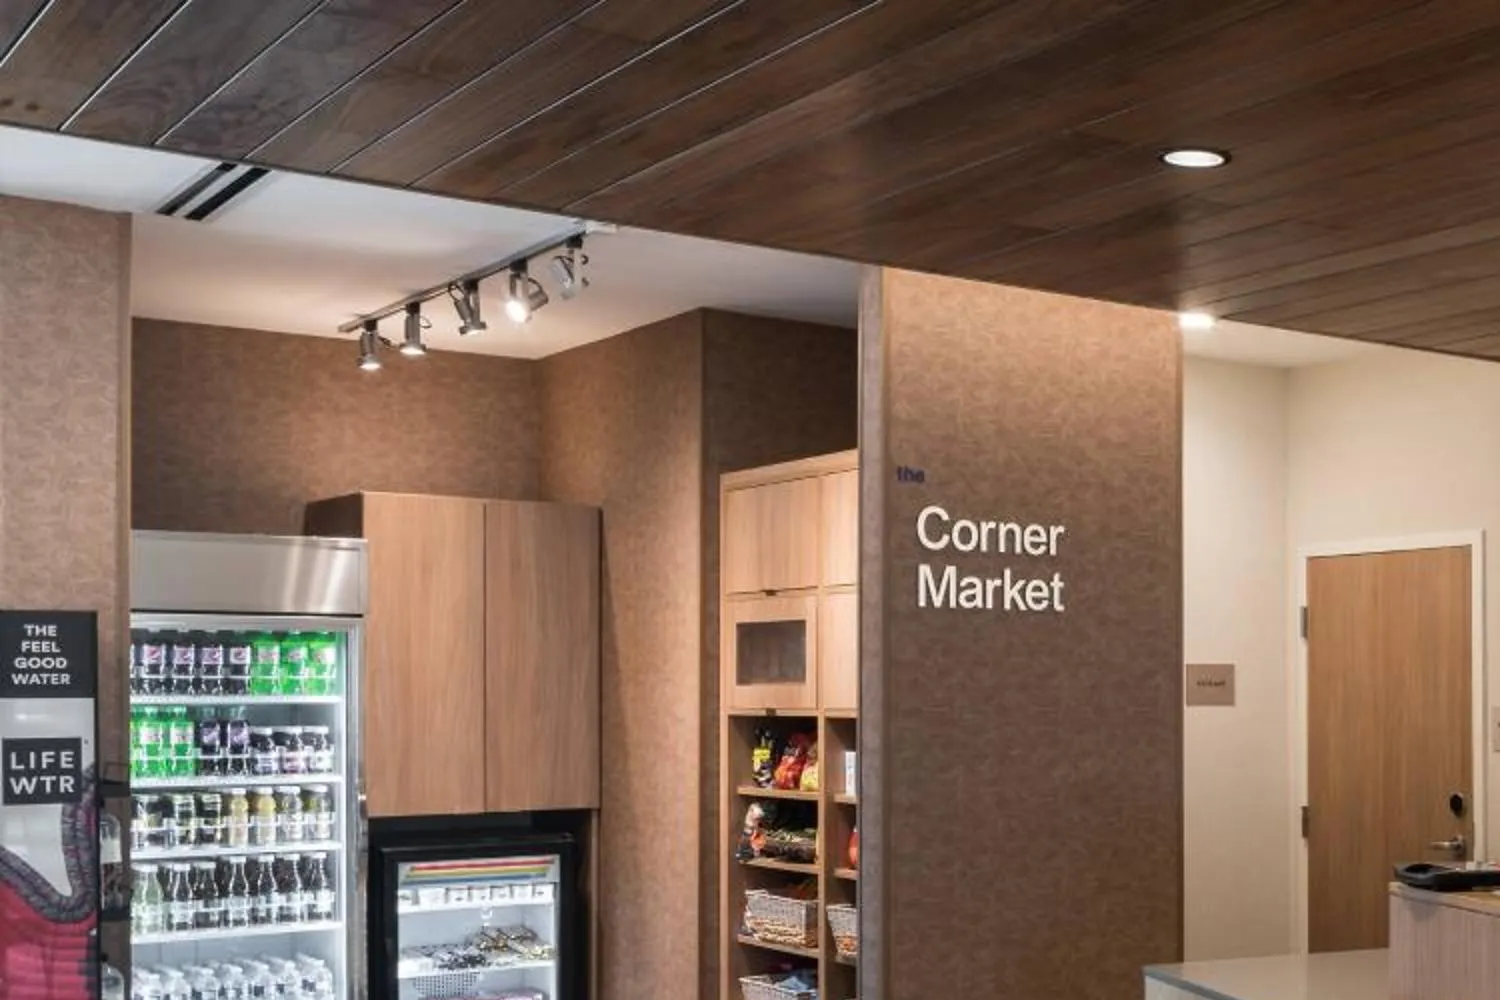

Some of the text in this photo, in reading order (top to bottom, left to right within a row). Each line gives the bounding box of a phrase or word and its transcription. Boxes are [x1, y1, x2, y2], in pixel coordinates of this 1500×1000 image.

[896, 466, 925, 483] the
[917, 505, 1065, 556] Corner
[917, 563, 1065, 612] Market
[23, 624, 57, 637] THE
[21, 641, 61, 653] FEEL
[14, 657, 67, 669] GOOD
[11, 673, 71, 685] WATER
[10, 751, 74, 769] LIFE
[10, 775, 75, 795] WTR
